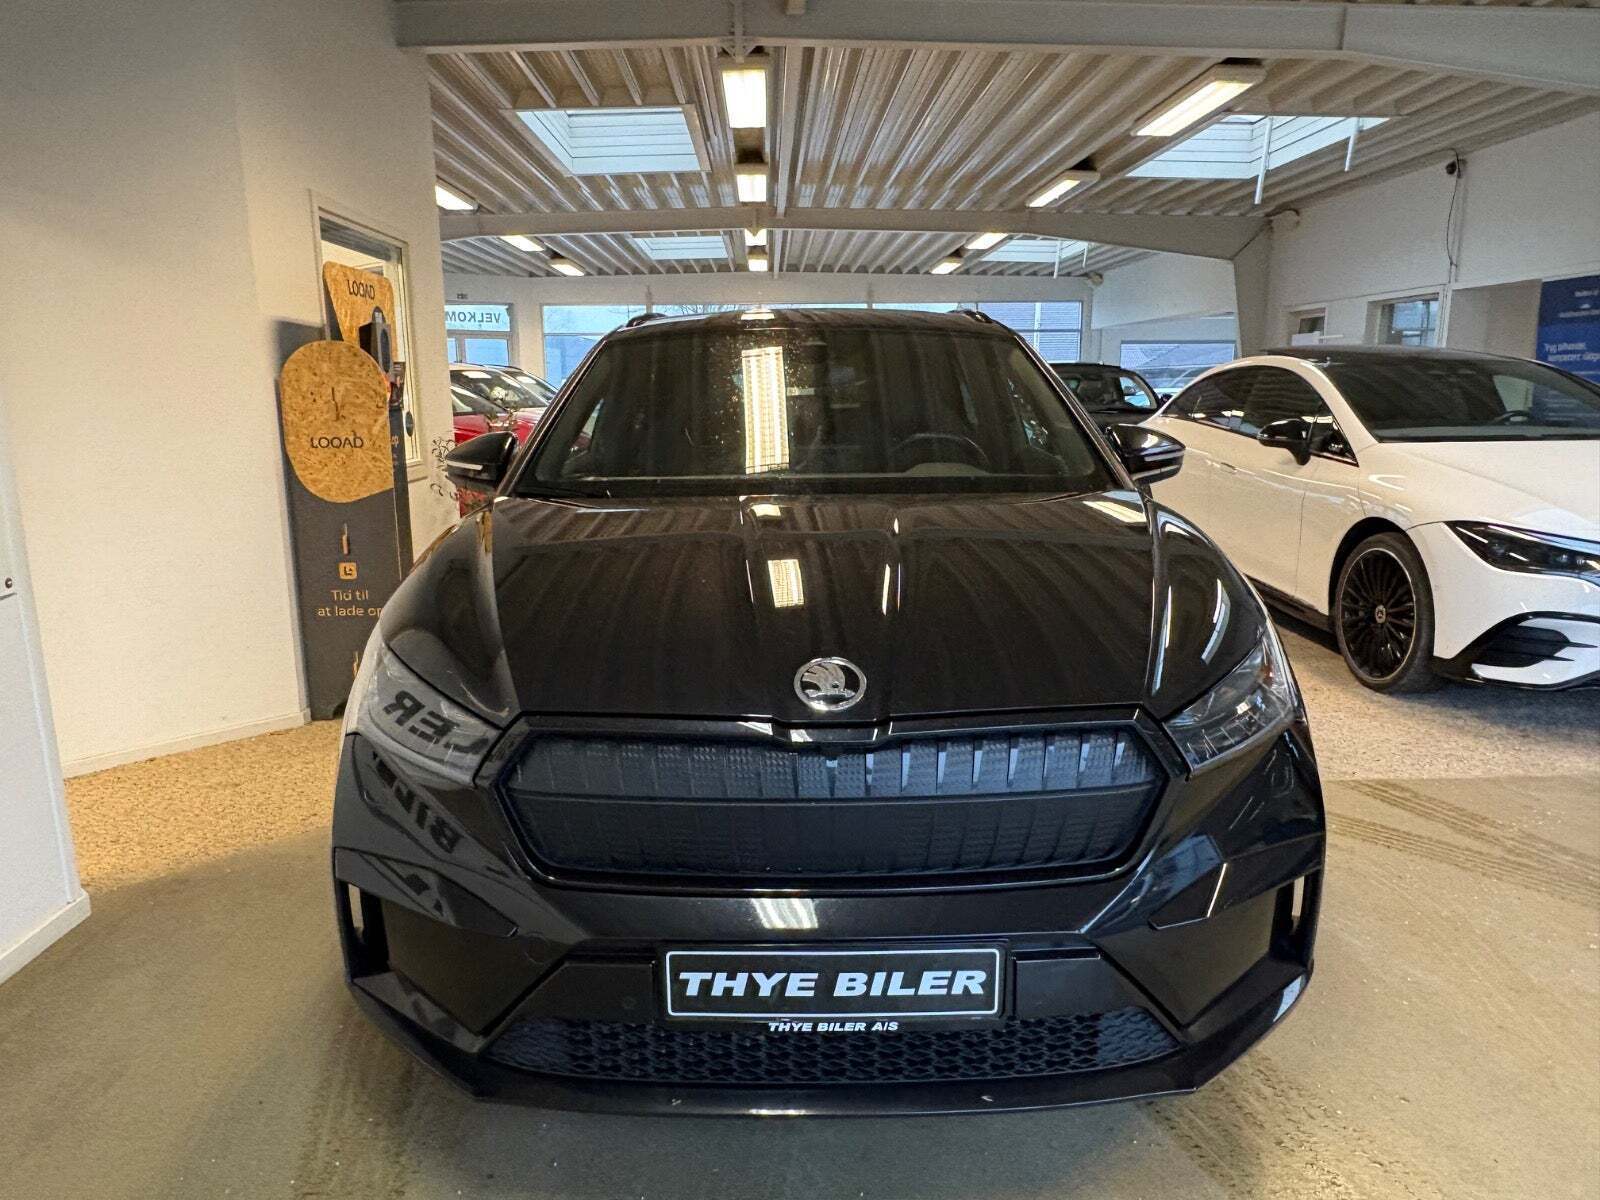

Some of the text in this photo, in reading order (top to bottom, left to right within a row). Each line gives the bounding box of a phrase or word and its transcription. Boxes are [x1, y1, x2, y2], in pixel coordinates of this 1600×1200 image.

[331, 588, 369, 601] Tid til
[318, 606, 331, 616] at
[335, 605, 365, 616] lade
[679, 970, 987, 998] THYE BILER
[768, 1021, 813, 1032] THYE
[817, 1021, 866, 1032] BILER
